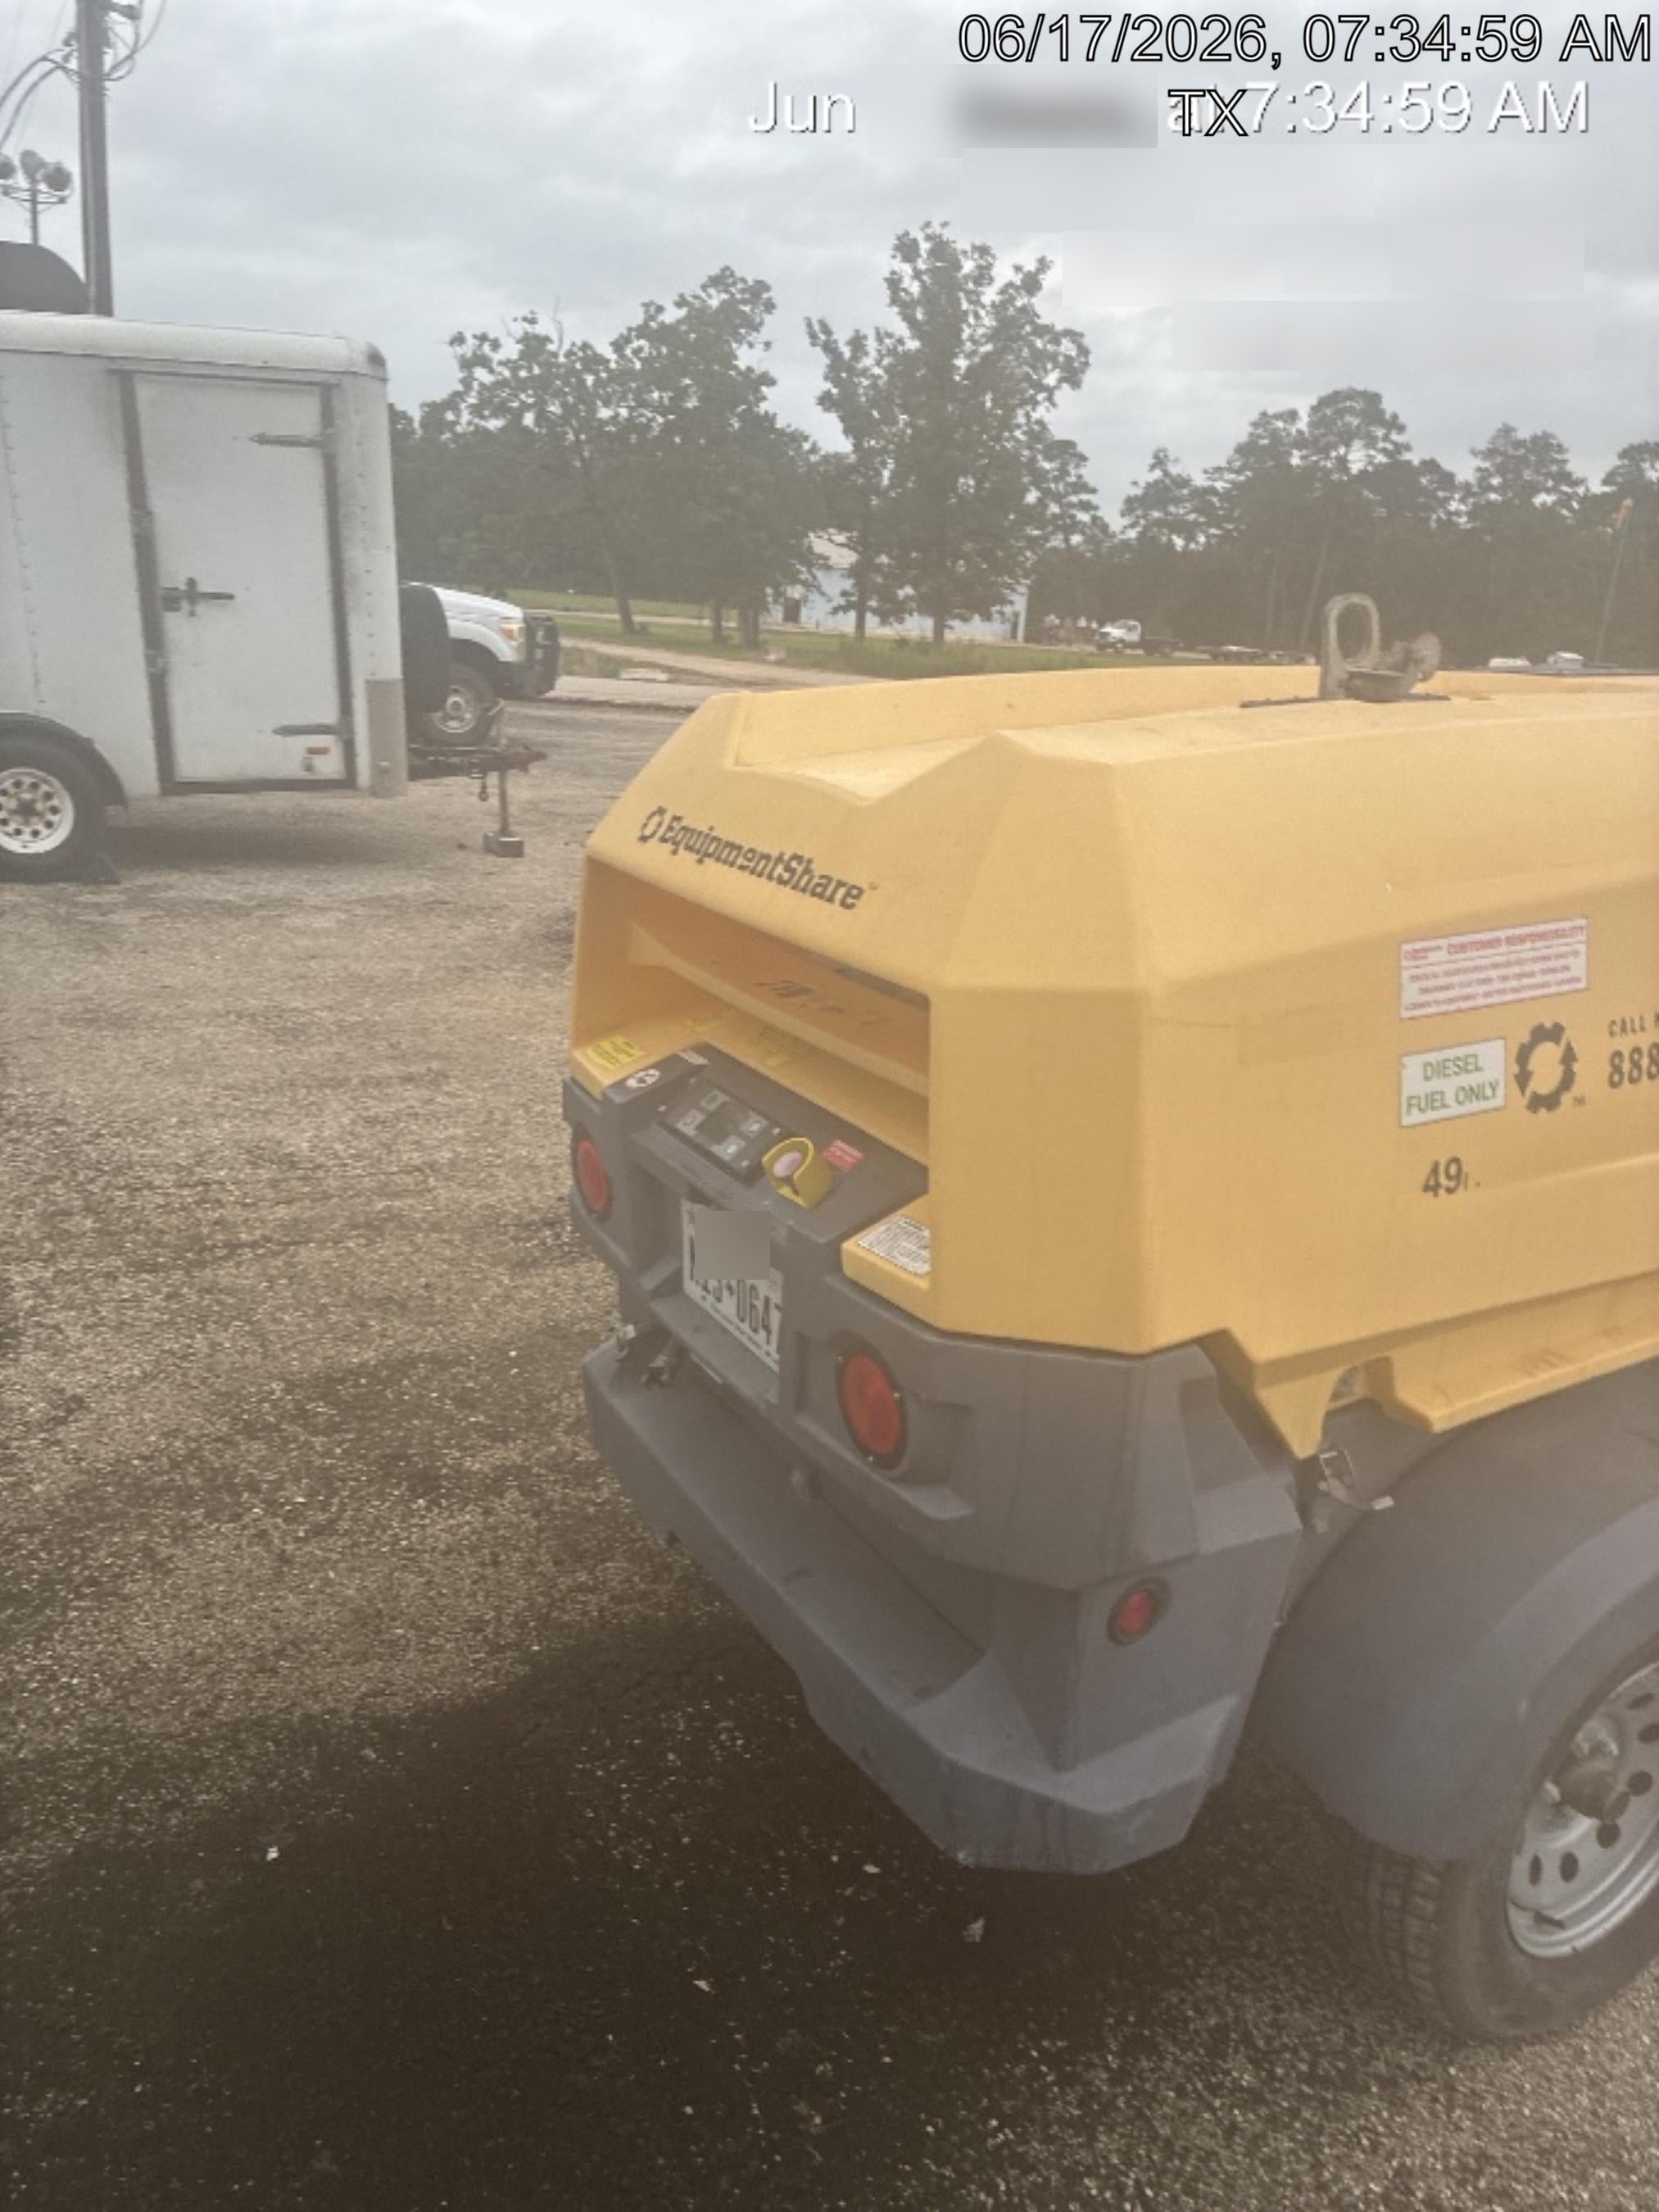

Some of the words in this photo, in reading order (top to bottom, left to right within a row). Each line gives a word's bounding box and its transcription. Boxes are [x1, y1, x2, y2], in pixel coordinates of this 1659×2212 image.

[659, 814, 865, 911] EquipmentShare
[1608, 1013, 1646, 1038] CALL
[1422, 1053, 1484, 1083] DIESEL
[1406, 1091, 1448, 1115] FUEL
[1455, 1079, 1501, 1106] ONLY
